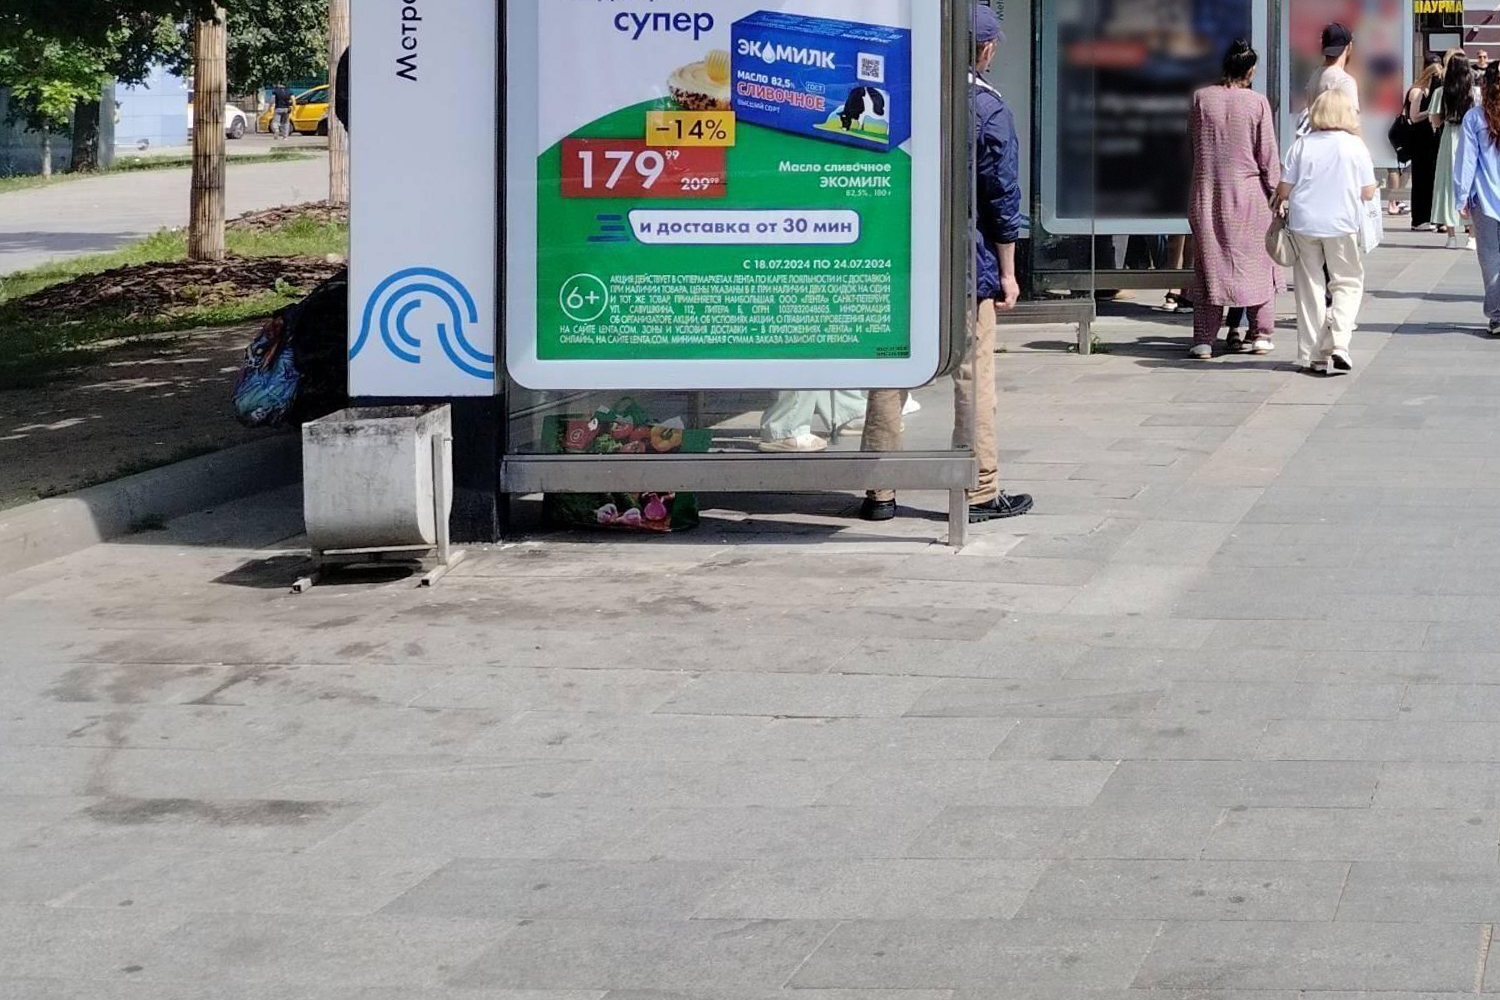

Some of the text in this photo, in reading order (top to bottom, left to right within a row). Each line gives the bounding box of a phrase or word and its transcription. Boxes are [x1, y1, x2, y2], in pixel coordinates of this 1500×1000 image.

[614, 12, 715, 41] супер
[737, 70, 769, 84] МАСЛО
[736, 81, 826, 112] СЛИВОЧНОЕ
[779, 161, 892, 172] Масло сливочное
[819, 176, 892, 188] ЭКОМИЛК
[640, 218, 852, 236] и доставка от 30 мин
[743, 259, 892, 269] С 18.07.2024 ПО 24.07.2024
[677, 275, 733, 283] СУПЕРМАРКЕТАХ
[733, 275, 754, 283] ЛЕНТА
[755, 275, 766, 283] ПО
[767, 275, 787, 283] КАРТЕ
[848, 273, 890, 283] ДОСТАВКОЙ
[610, 285, 623, 293] ПРИ
[757, 285, 772, 293] ПРИ
[858, 285, 868, 293] НА
[567, 286, 600, 309] 6+
[620, 295, 631, 303] ТОТ
[635, 295, 645, 303] ЖЕ
[779, 295, 797, 303] ООО
[560, 325, 570, 333] НА
[573, 323, 595, 333] САЙТЕ
[641, 325, 662, 333] ЗОНЫ
[710, 325, 747, 334] ДОСТАВКИ
[596, 335, 606, 343] НА
[672, 335, 727, 343] МИНИМАЛЬНАЯ
[727, 335, 754, 343] СУММА
[755, 335, 782, 343] ЗАКАЗА
[784, 335, 815, 343] ЗАВИСИТ
